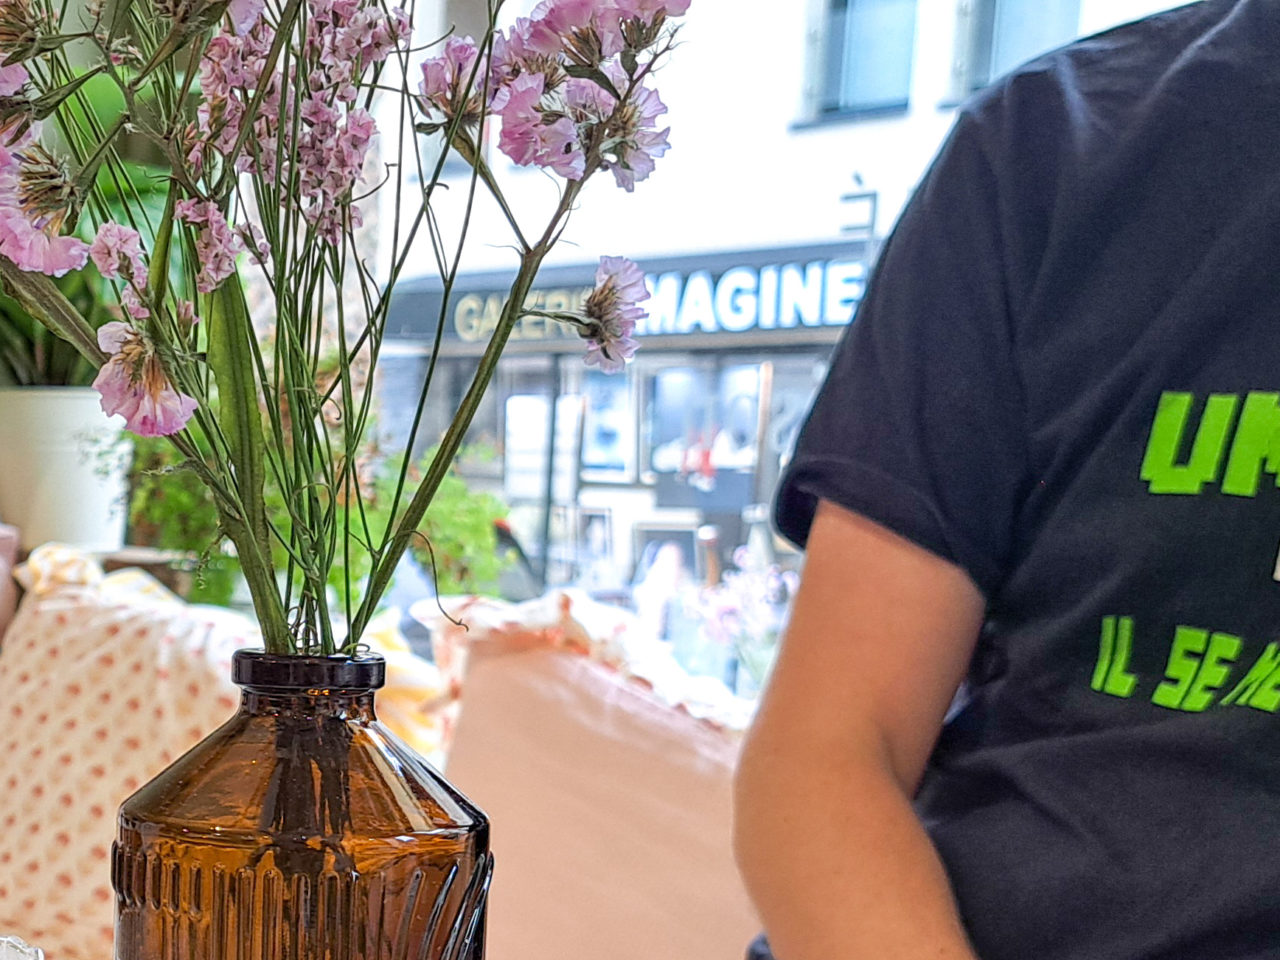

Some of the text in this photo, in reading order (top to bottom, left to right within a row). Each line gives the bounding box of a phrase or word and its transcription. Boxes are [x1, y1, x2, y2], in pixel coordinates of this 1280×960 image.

[454, 258, 868, 342] GAERI MAGINE
[1090, 614, 1138, 699] IL
[1150, 624, 1244, 713] SE
